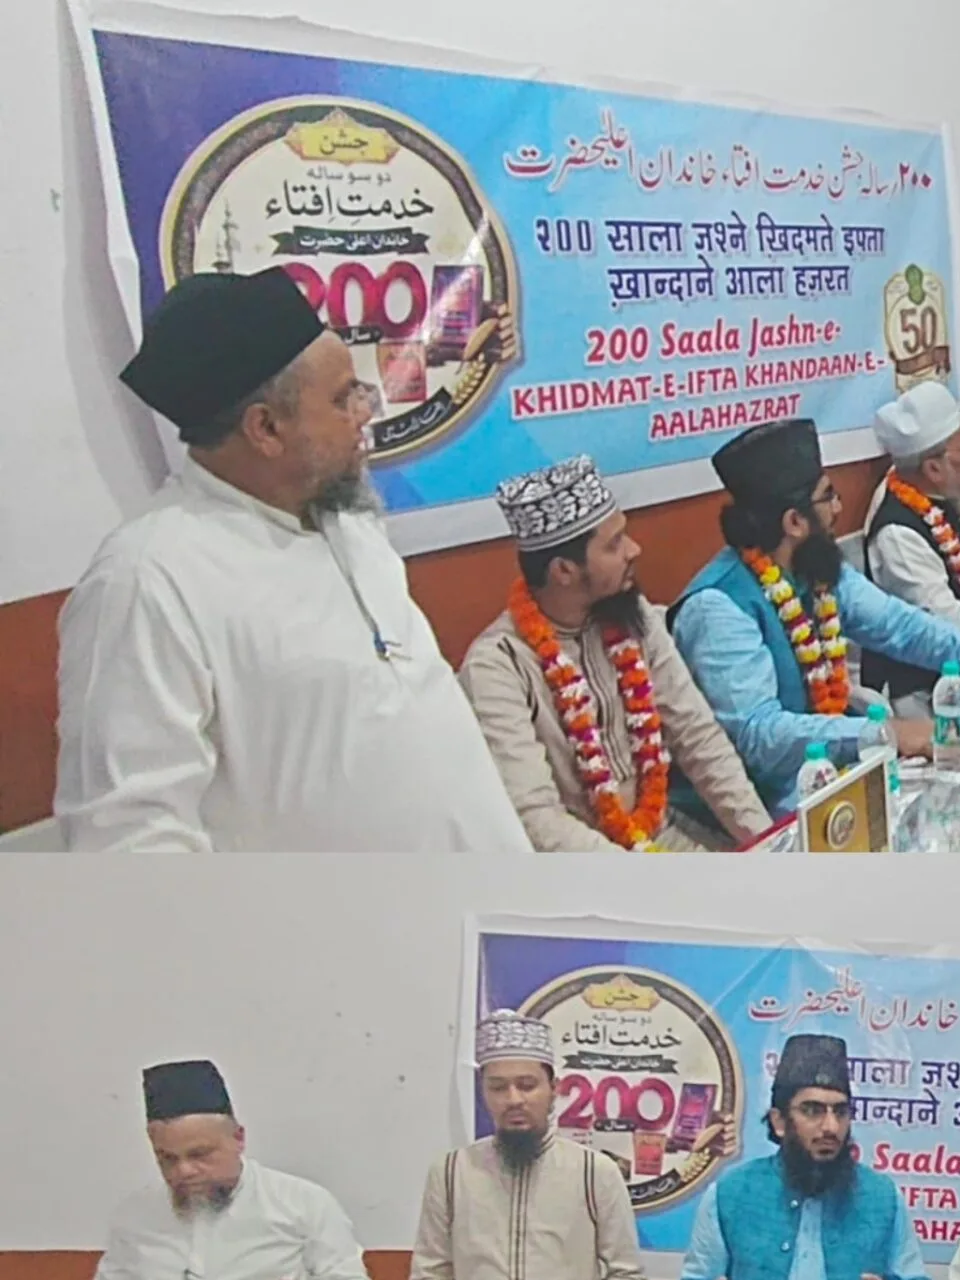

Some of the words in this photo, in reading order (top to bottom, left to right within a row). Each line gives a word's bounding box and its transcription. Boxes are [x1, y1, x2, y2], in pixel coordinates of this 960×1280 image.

[319, 130, 368, 154] جشن
[640, 149, 716, 188] خاندان
[763, 164, 824, 189] خدمت
[605, 220, 682, 252] साला
[726, 265, 784, 296] आला
[586, 326, 649, 363] 200
[661, 317, 740, 357] Saala
[899, 306, 938, 354] 50
[513, 366, 738, 416] KHIDMAT-E-IFTA
[745, 351, 885, 388] KHANDAAN-E-
[651, 393, 801, 439] AALAHAZRAT
[605, 988, 639, 1006] جشن
[869, 998, 958, 1031] خاندان
[556, 1073, 675, 1131] 200
